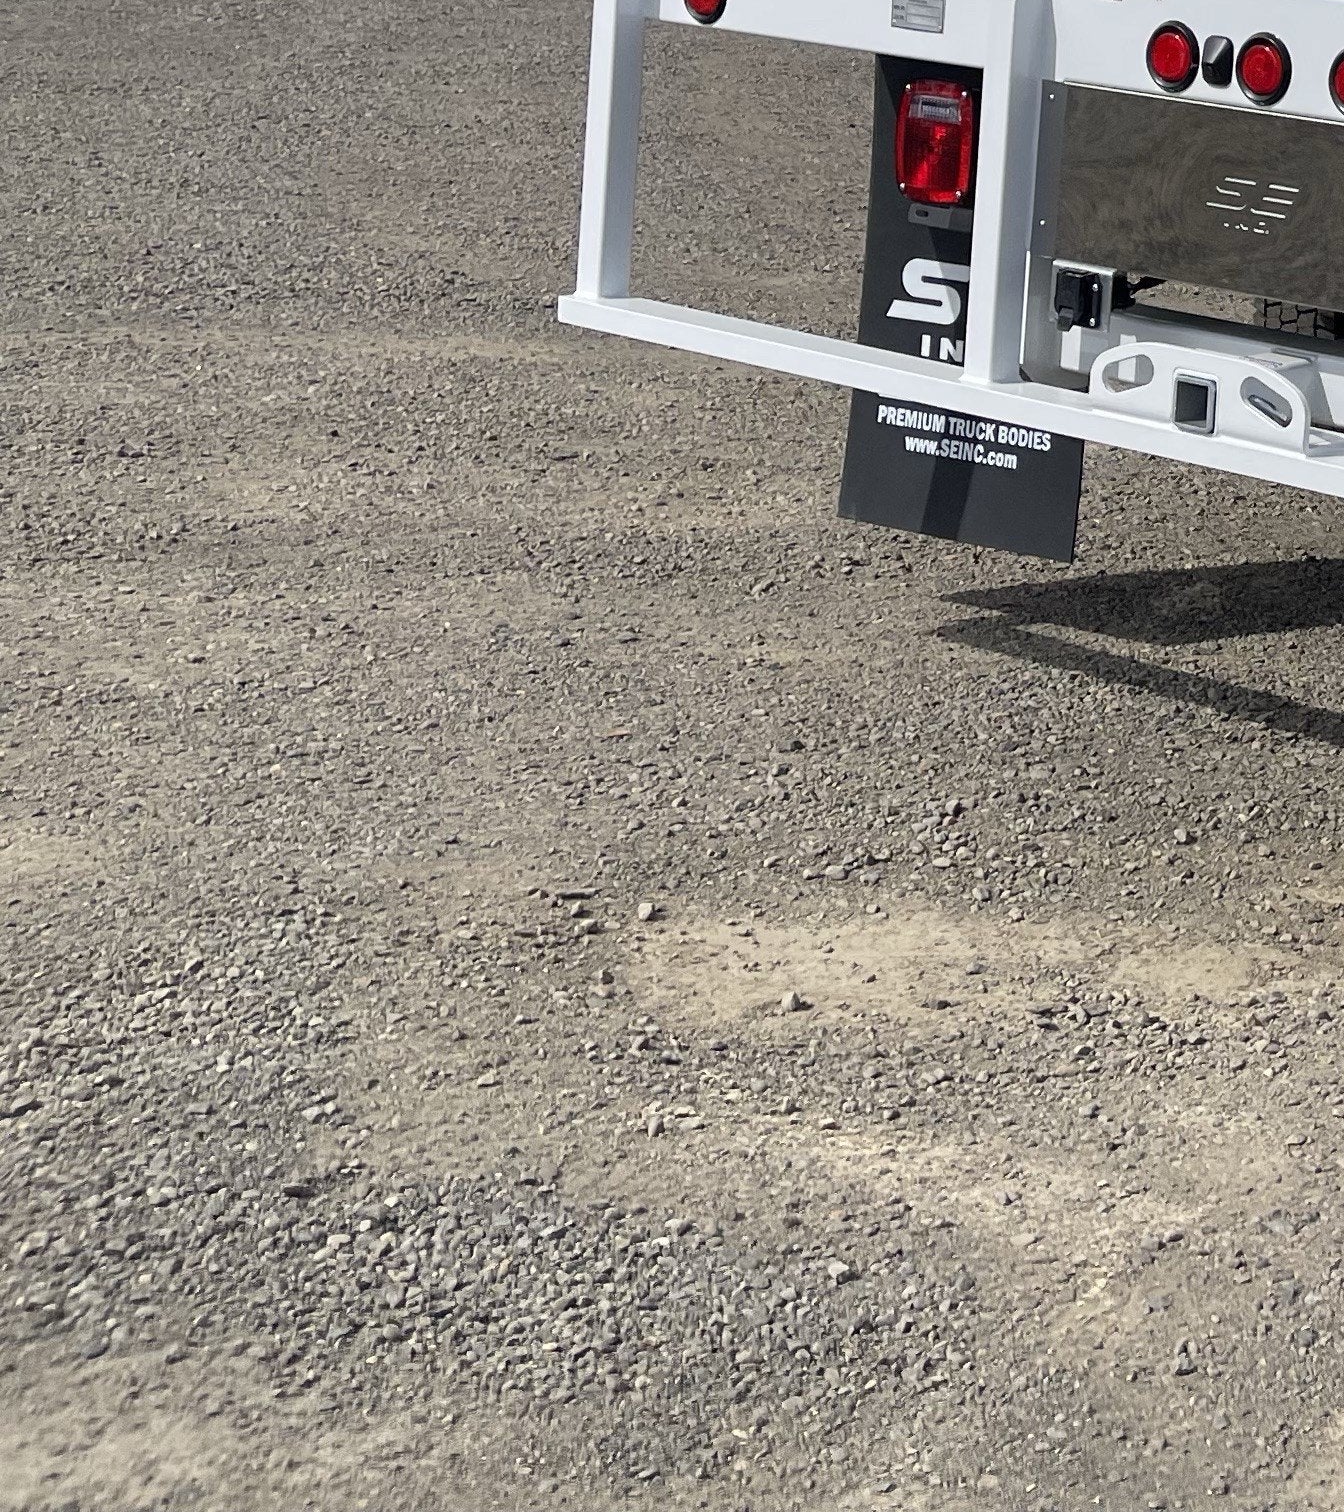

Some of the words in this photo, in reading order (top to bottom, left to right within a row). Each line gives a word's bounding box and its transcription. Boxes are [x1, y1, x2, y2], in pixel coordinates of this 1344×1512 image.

[886, 257, 970, 326] S
[921, 334, 964, 363] IN
[877, 404, 946, 434] PREMIUM
[948, 416, 996, 443] TRUCK
[998, 425, 1052, 452] BODIES
[904, 435, 1018, 470] www.SEINC.com
